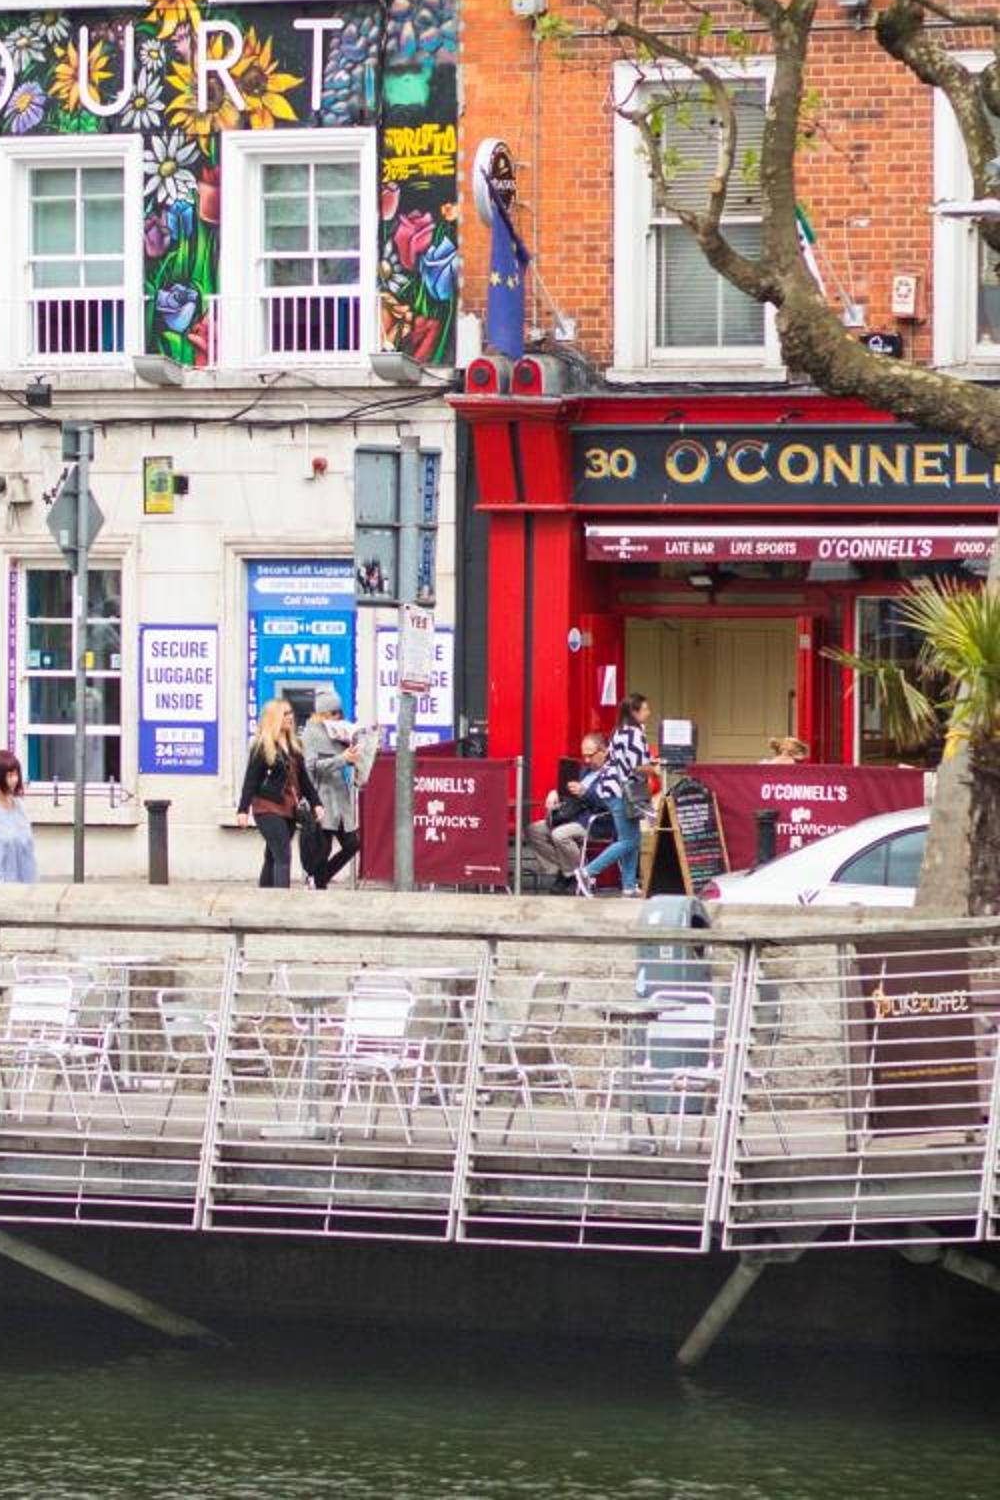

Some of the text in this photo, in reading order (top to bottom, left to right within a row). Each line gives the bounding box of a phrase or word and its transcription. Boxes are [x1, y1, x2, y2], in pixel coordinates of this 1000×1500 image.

[583, 438, 1000, 488] 30 O'CONNEL
[664, 542, 690, 555] LATE
[692, 542, 715, 555] BAR
[730, 542, 753, 555] LIVE
[755, 542, 797, 555] SPORTS
[818, 538, 934, 558] O'CONNELL'S
[292, 564, 312, 575] Left
[409, 615, 428, 629] YES
[151, 641, 209, 658] SECURE
[279, 643, 331, 664] ATM
[146, 667, 213, 685] LUGGAGE
[380, 670, 449, 687] LUGE
[155, 693, 204, 710] INSIDE
[155, 743, 174, 757] 24
[760, 784, 848, 802] O'CONNELL'S
[413, 815, 482, 829] ITHWICK'S
